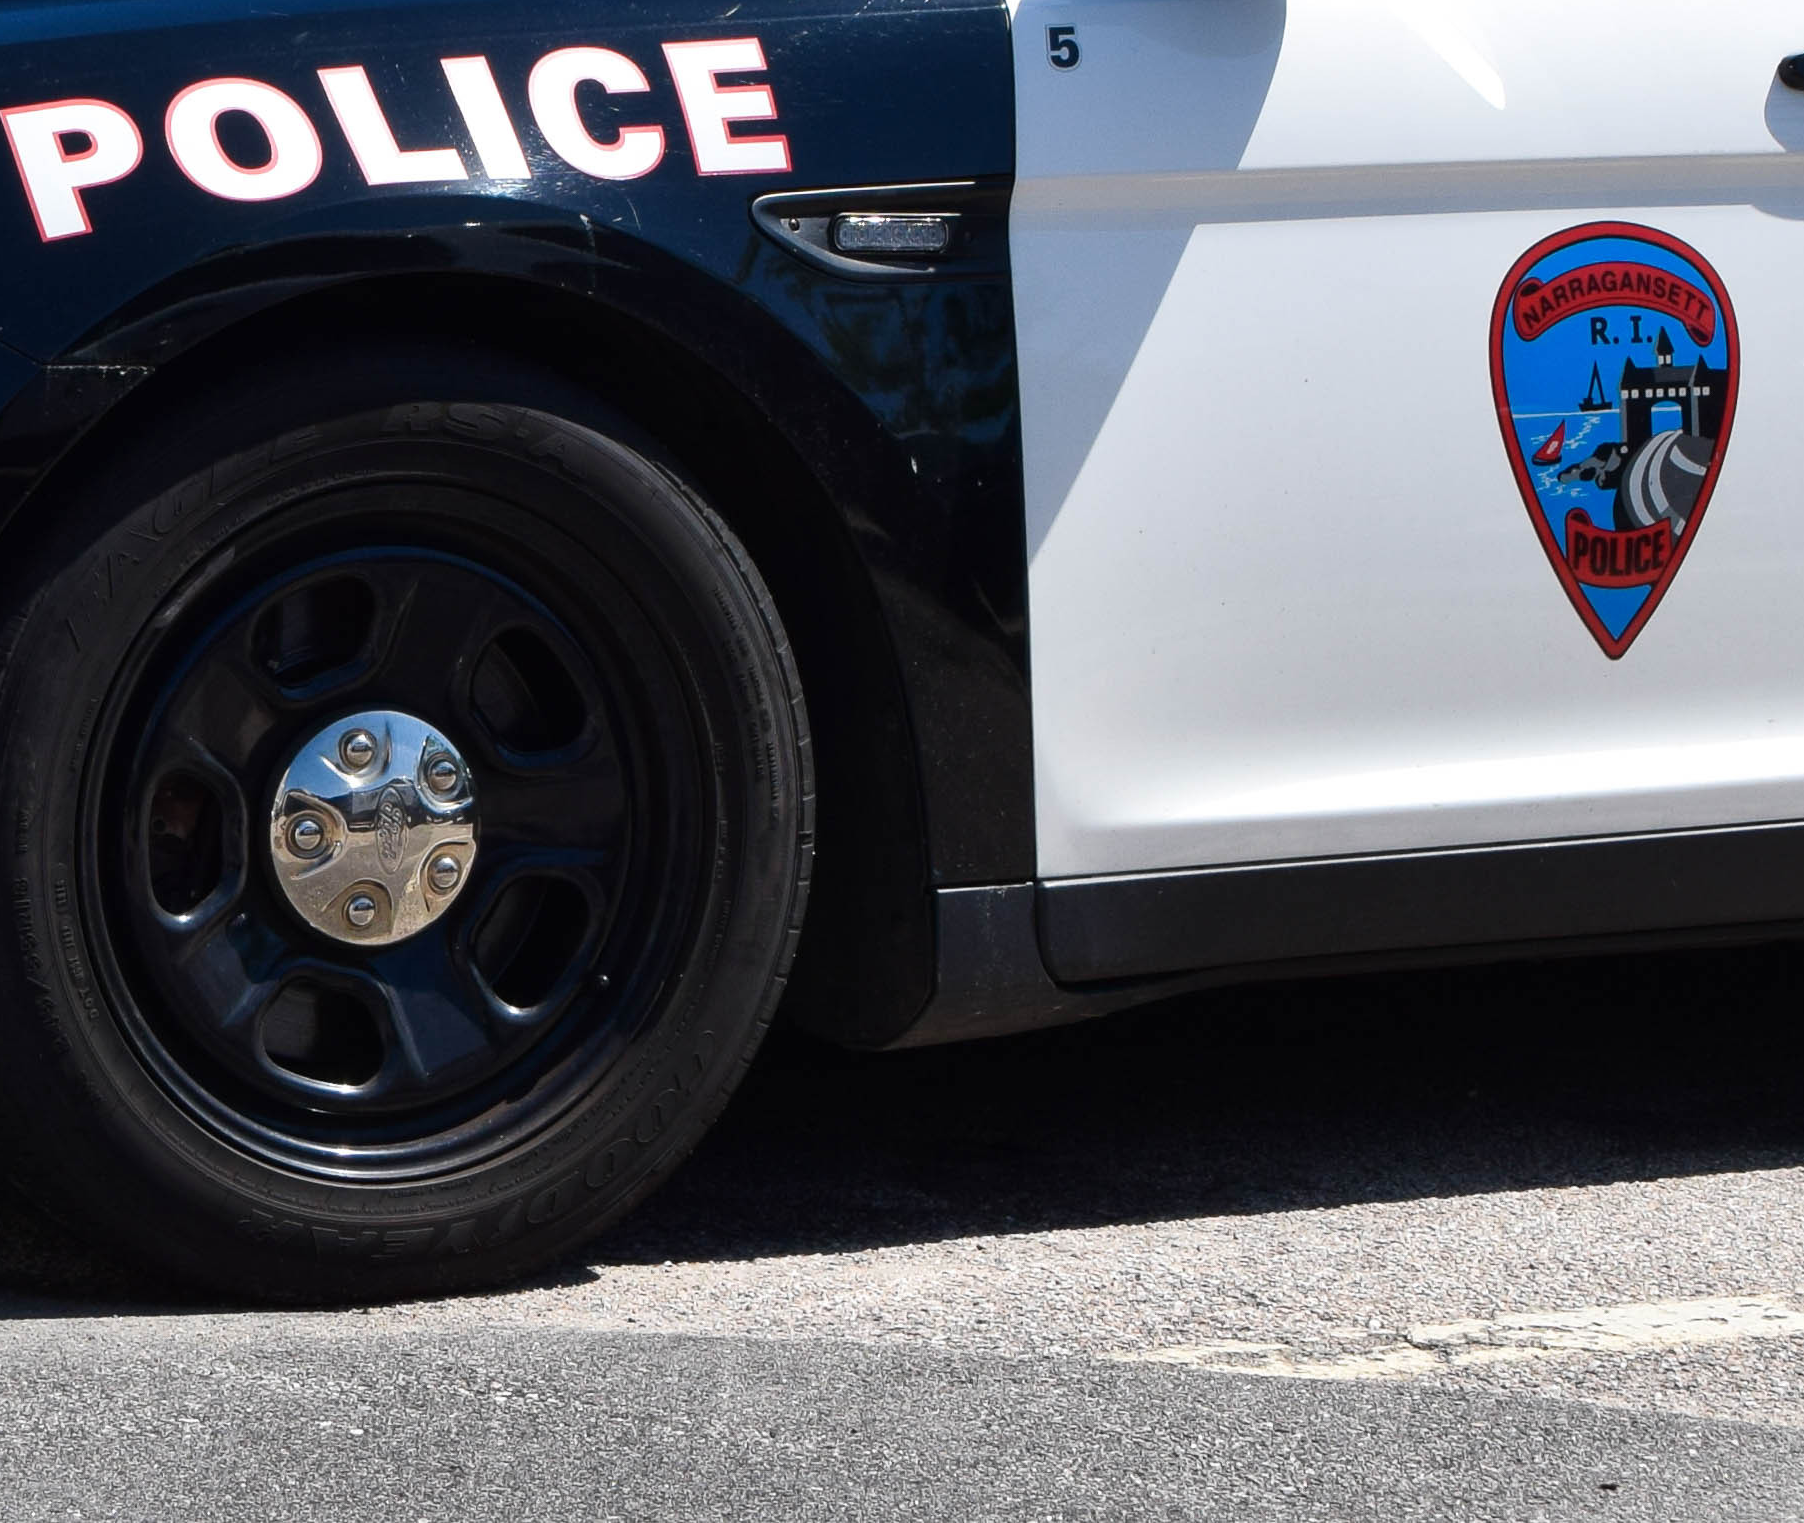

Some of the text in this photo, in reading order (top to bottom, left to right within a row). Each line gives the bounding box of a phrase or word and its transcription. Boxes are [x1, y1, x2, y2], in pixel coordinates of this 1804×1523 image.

[1047, 23, 1081, 70] 5
[1521, 271, 1711, 329] NARRAGANSETT
[1573, 528, 1666, 576] POLICE
